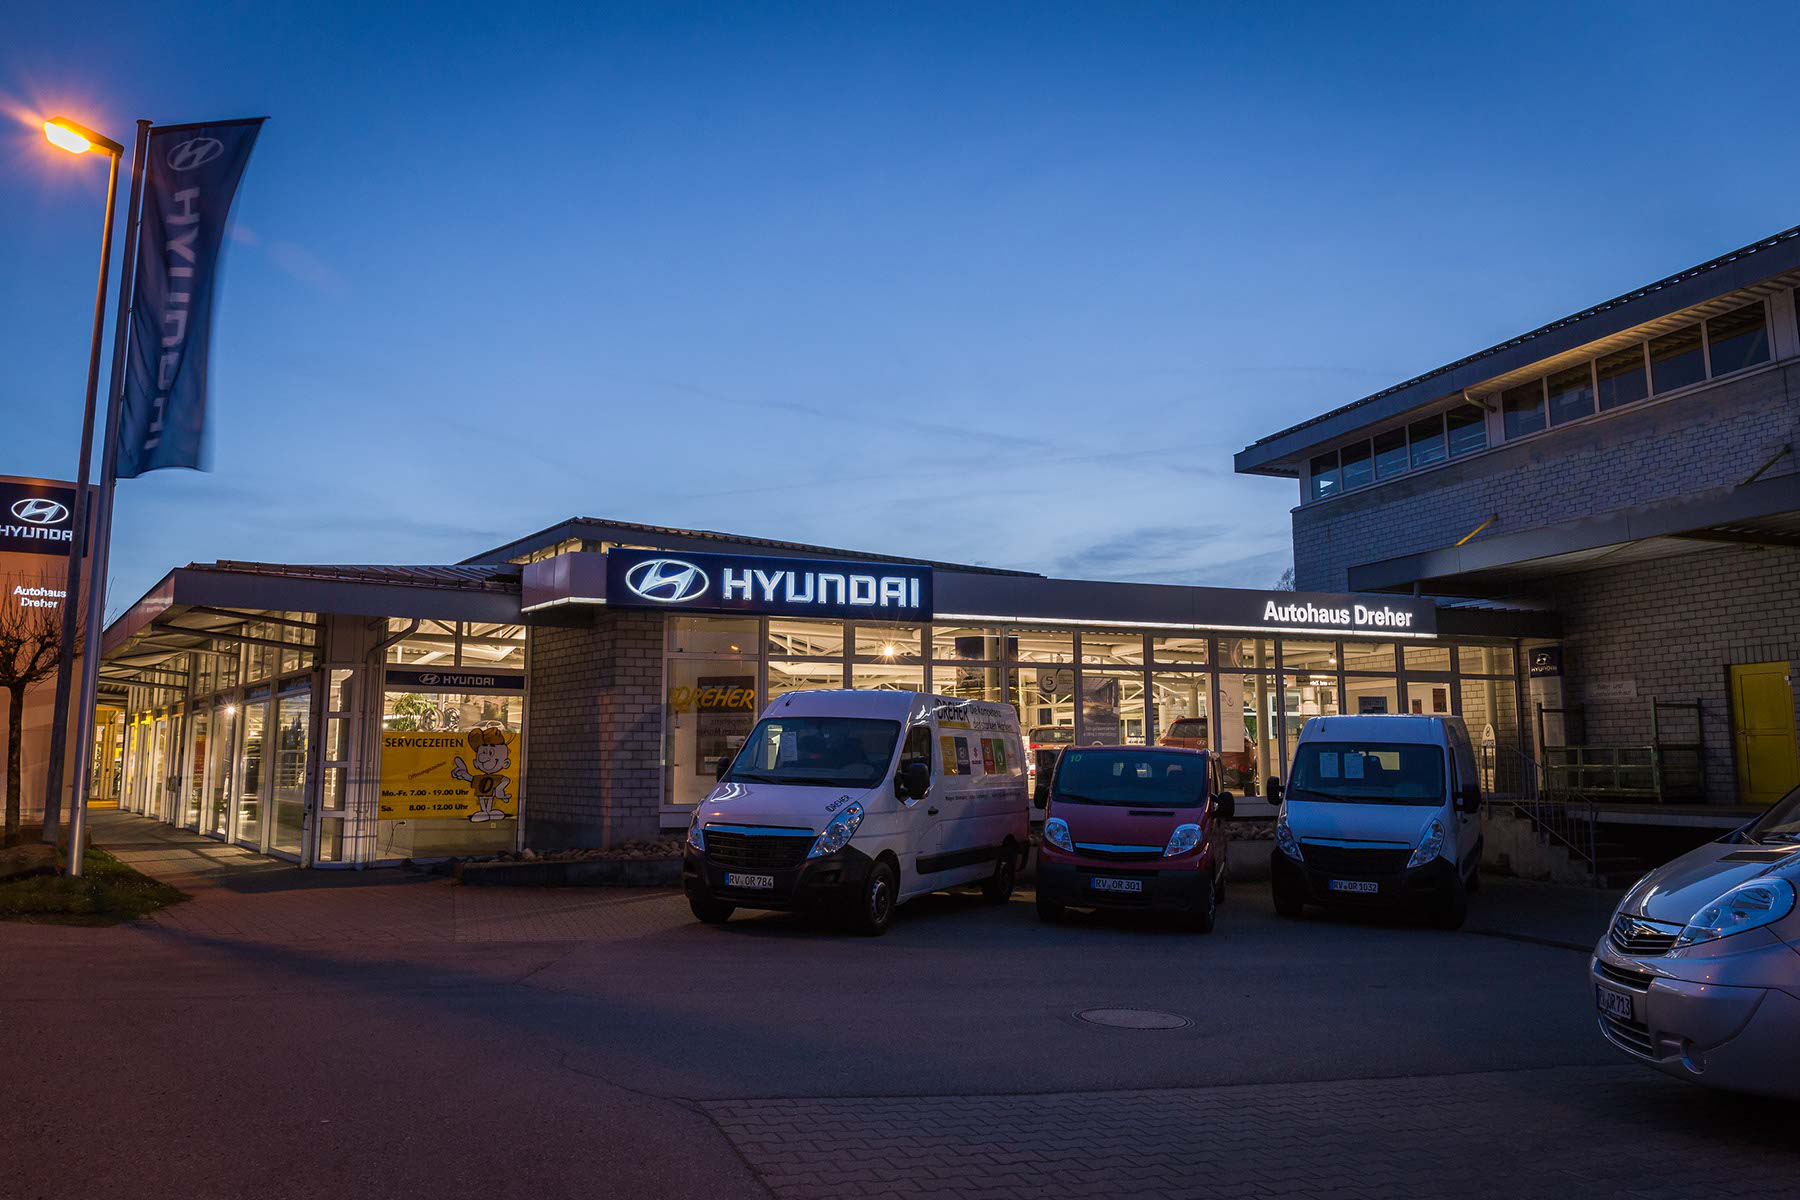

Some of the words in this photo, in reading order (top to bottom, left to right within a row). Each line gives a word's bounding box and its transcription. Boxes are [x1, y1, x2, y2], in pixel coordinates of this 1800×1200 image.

[0, 524, 73, 541] HYUNDA
[13, 586, 66, 598] Autohaus
[723, 567, 919, 608] HYUNDAI
[21, 597, 58, 608] Dreher
[1263, 601, 1350, 624] Autohaus
[1354, 604, 1413, 627] Dreher
[443, 675, 495, 686] HYUNDAI
[672, 686, 755, 710] DREHER
[936, 698, 970, 723] DREHER
[385, 738, 464, 748] SERVICEZEITEN
[410, 789, 427, 797] 7.00
[433, 789, 454, 797] 19.00
